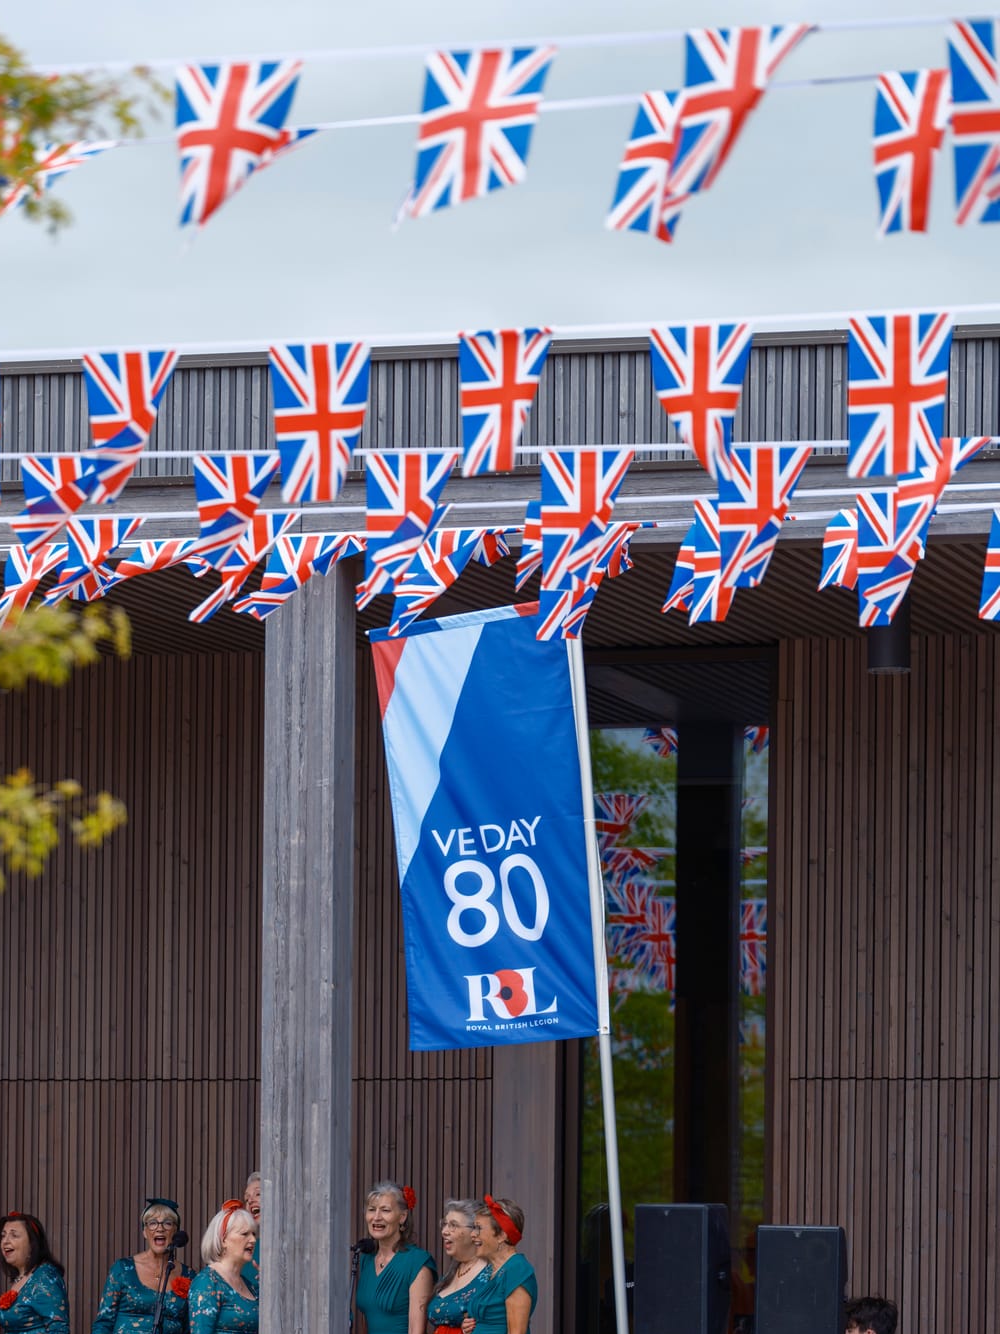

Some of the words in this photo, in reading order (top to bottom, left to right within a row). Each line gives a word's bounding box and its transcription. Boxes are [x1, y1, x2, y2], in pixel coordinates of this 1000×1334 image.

[431, 827, 477, 857] VE
[479, 816, 542, 853] DAY
[443, 853, 550, 948] 80
[465, 1024, 493, 1032] ROYAL
[495, 1021, 528, 1031] BRITISH
[529, 1016, 559, 1027] LEGION
